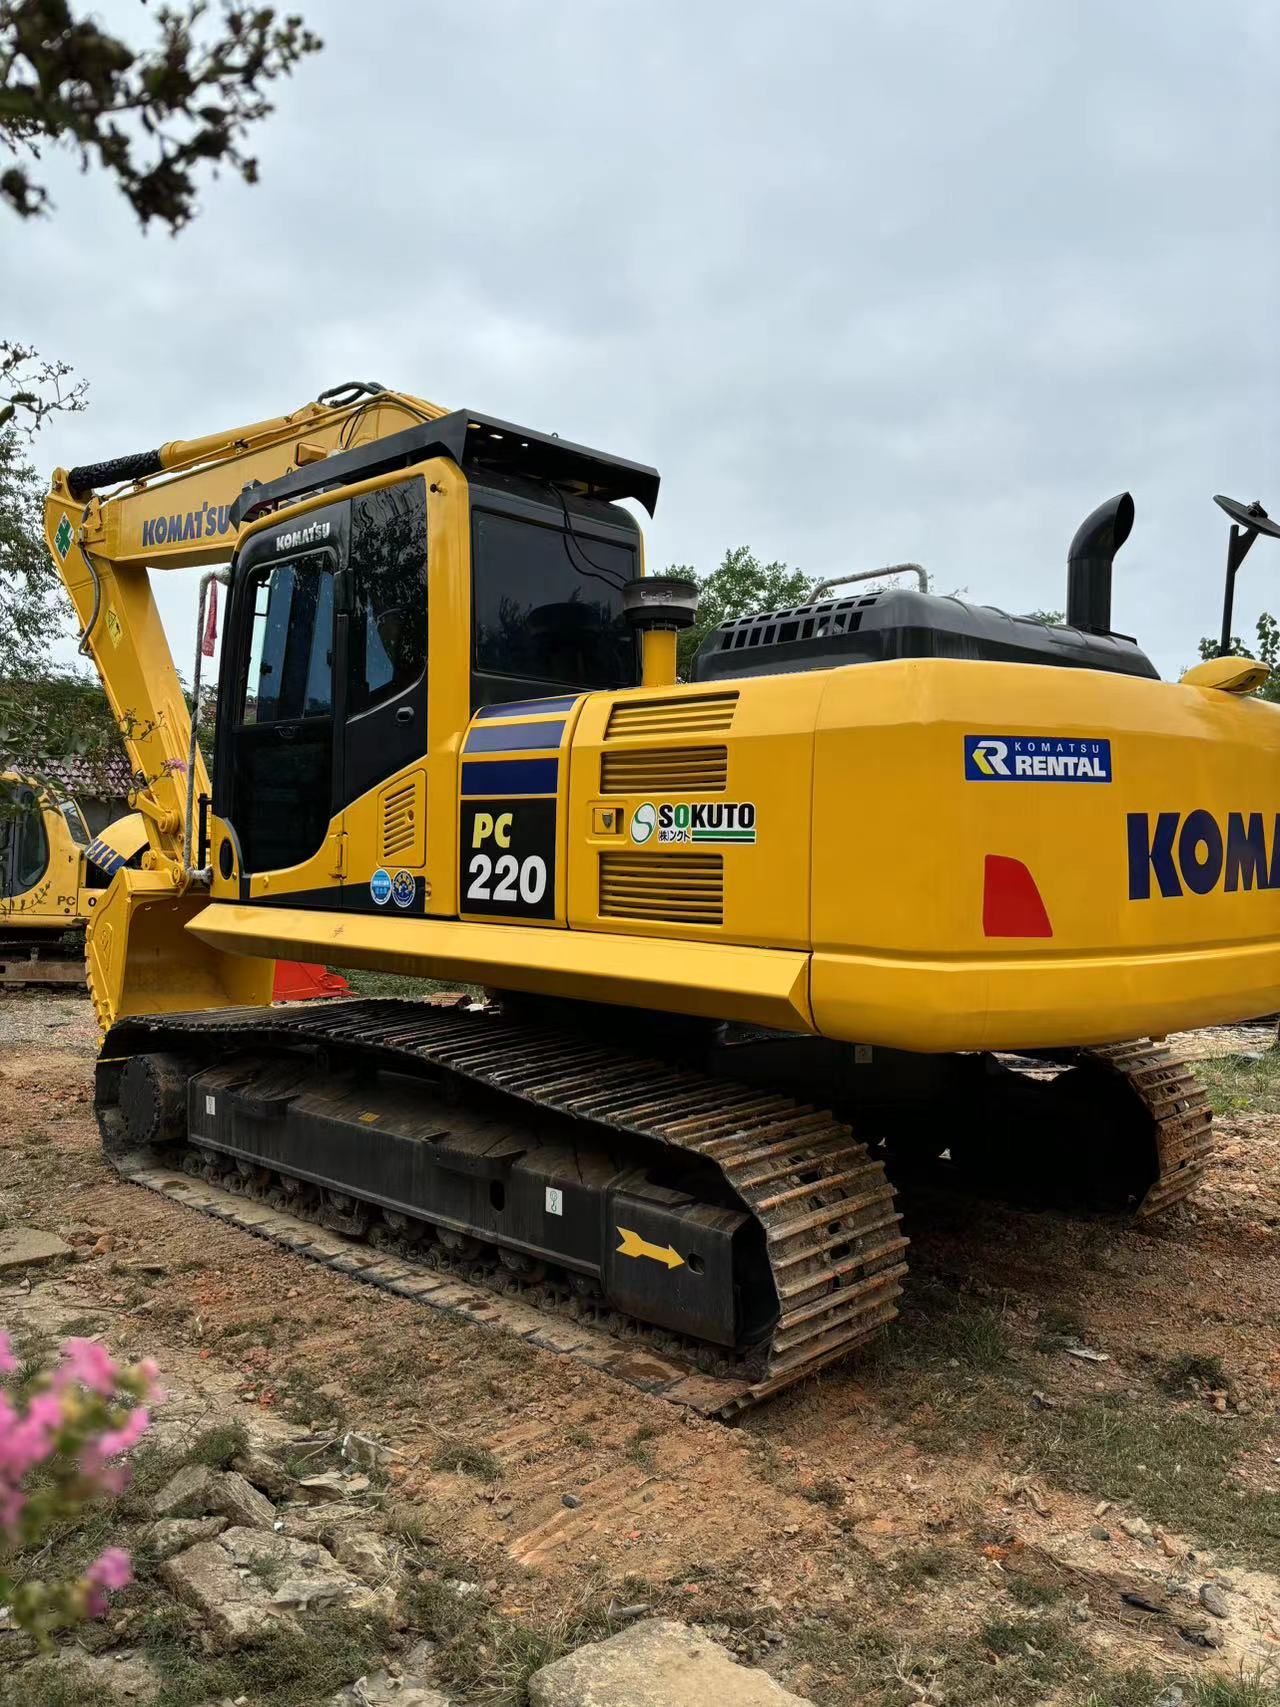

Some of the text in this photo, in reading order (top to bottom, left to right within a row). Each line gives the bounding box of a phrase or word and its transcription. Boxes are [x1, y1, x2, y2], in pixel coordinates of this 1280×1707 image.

[1015, 742, 1099, 754] KOMATSU
[1015, 755, 1106, 777] RENTAL
[658, 803, 755, 829] SOKUTO
[472, 812, 513, 848] PC
[467, 853, 547, 904] 220
[57, 895, 76, 906] PC
